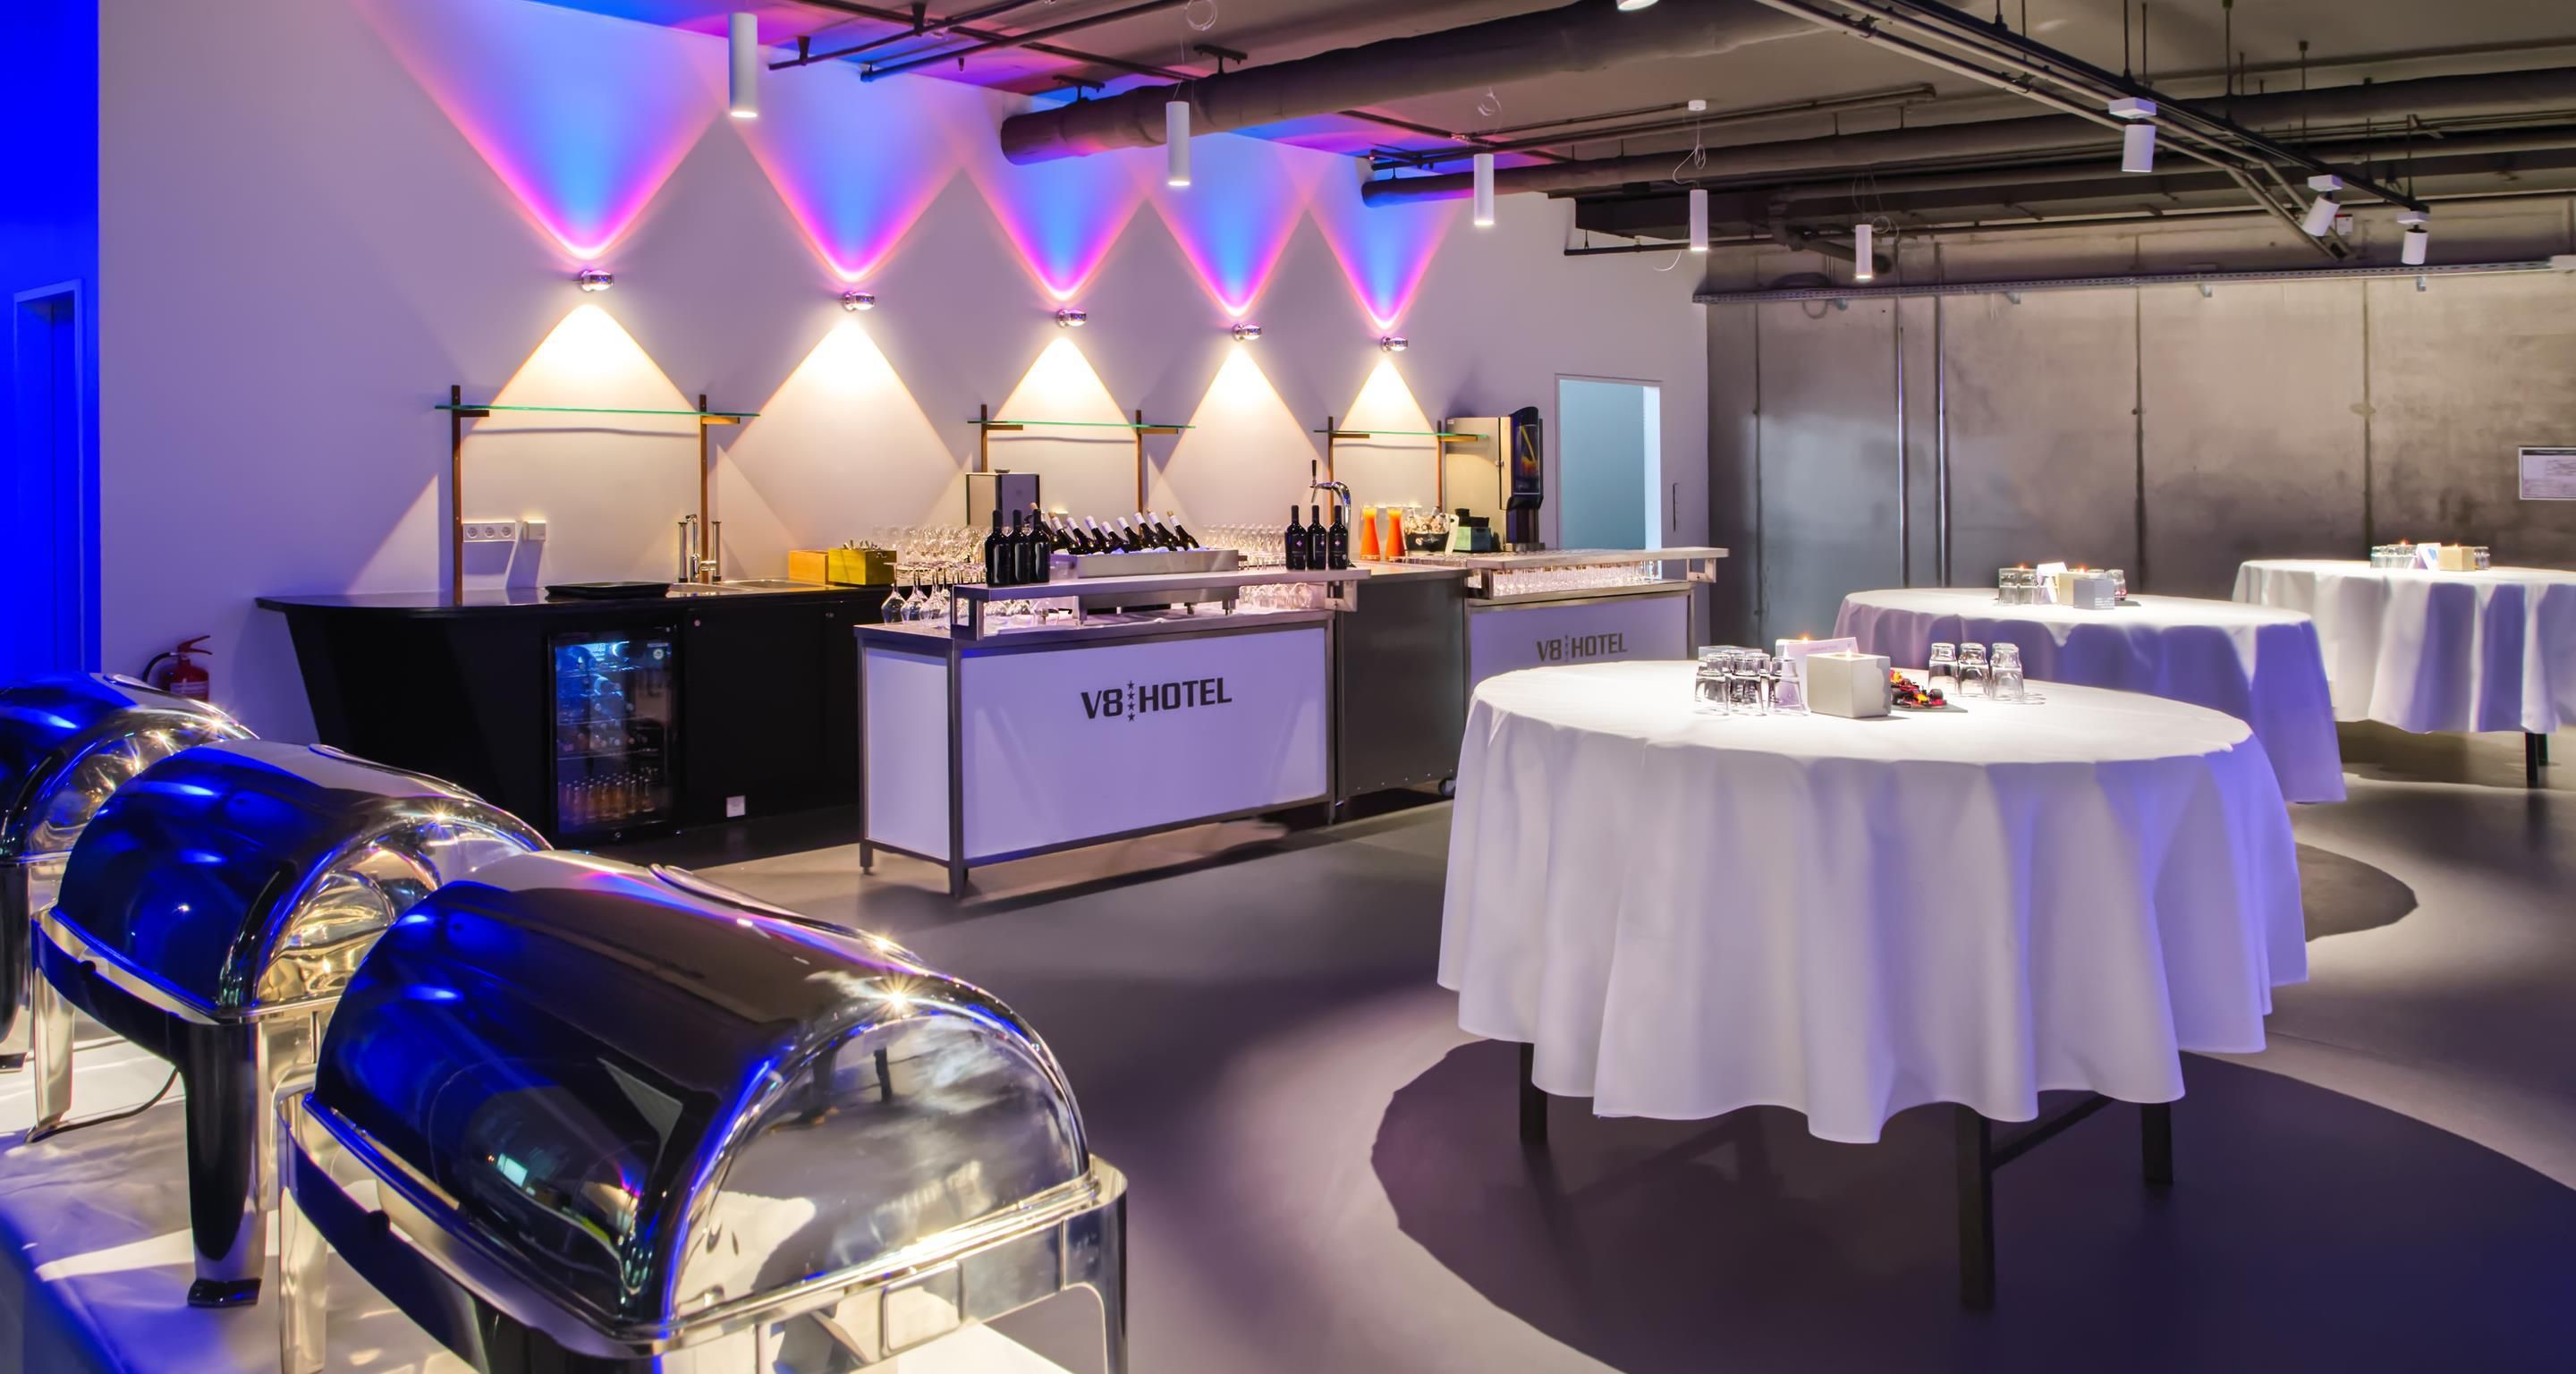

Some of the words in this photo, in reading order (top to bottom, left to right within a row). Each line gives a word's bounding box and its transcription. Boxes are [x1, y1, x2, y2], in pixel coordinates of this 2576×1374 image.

[1537, 639, 1562, 662] V8
[1572, 632, 1628, 658] HOTEL
[1080, 688, 1123, 719] V8
[1139, 677, 1233, 713] HOTEL
